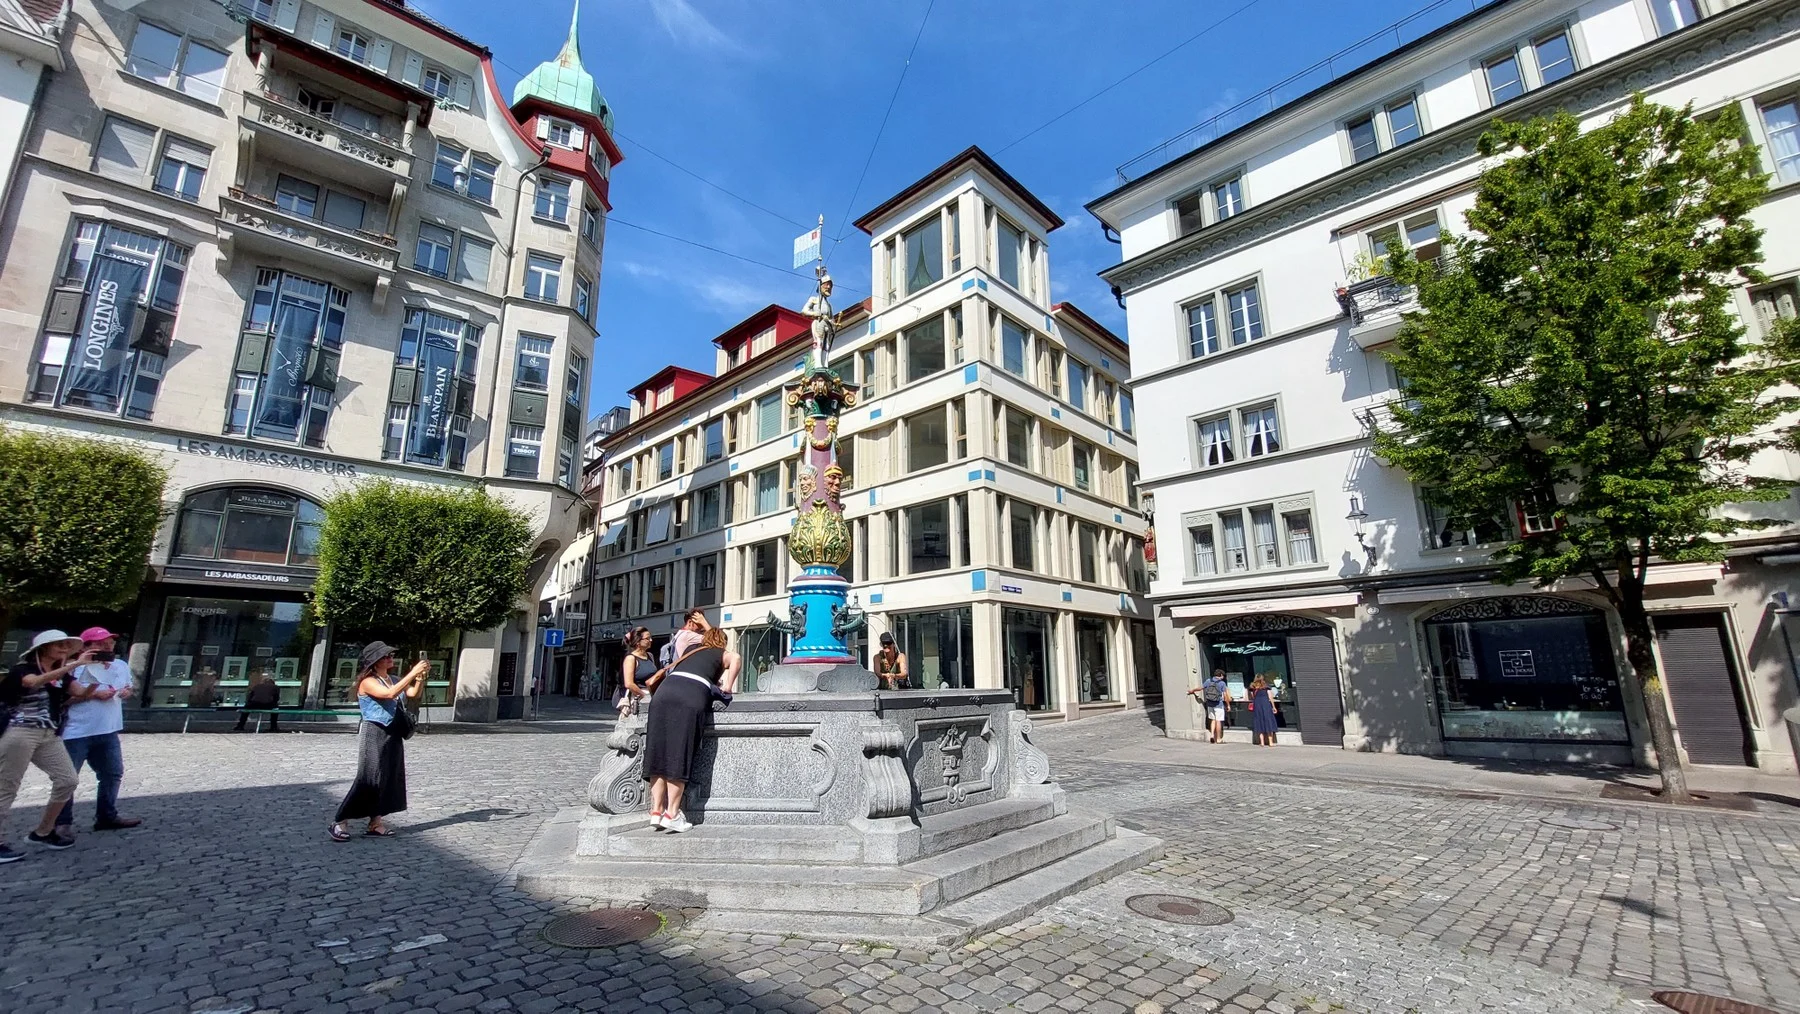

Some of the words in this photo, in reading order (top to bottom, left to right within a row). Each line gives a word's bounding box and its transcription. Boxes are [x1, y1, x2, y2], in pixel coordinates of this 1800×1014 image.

[84, 280, 118, 370] LONGINES
[426, 366, 447, 438] BLANCPAIN
[177, 438, 211, 456] LES
[215, 445, 357, 477] AMBASSADEURS
[241, 496, 287, 506] BLANCPAIN
[222, 572, 289, 582] AMBASSADEURS
[181, 606, 227, 615] LONGINES
[1212, 642, 1244, 654] Thomas
[1243, 641, 1277, 654] Sabo
